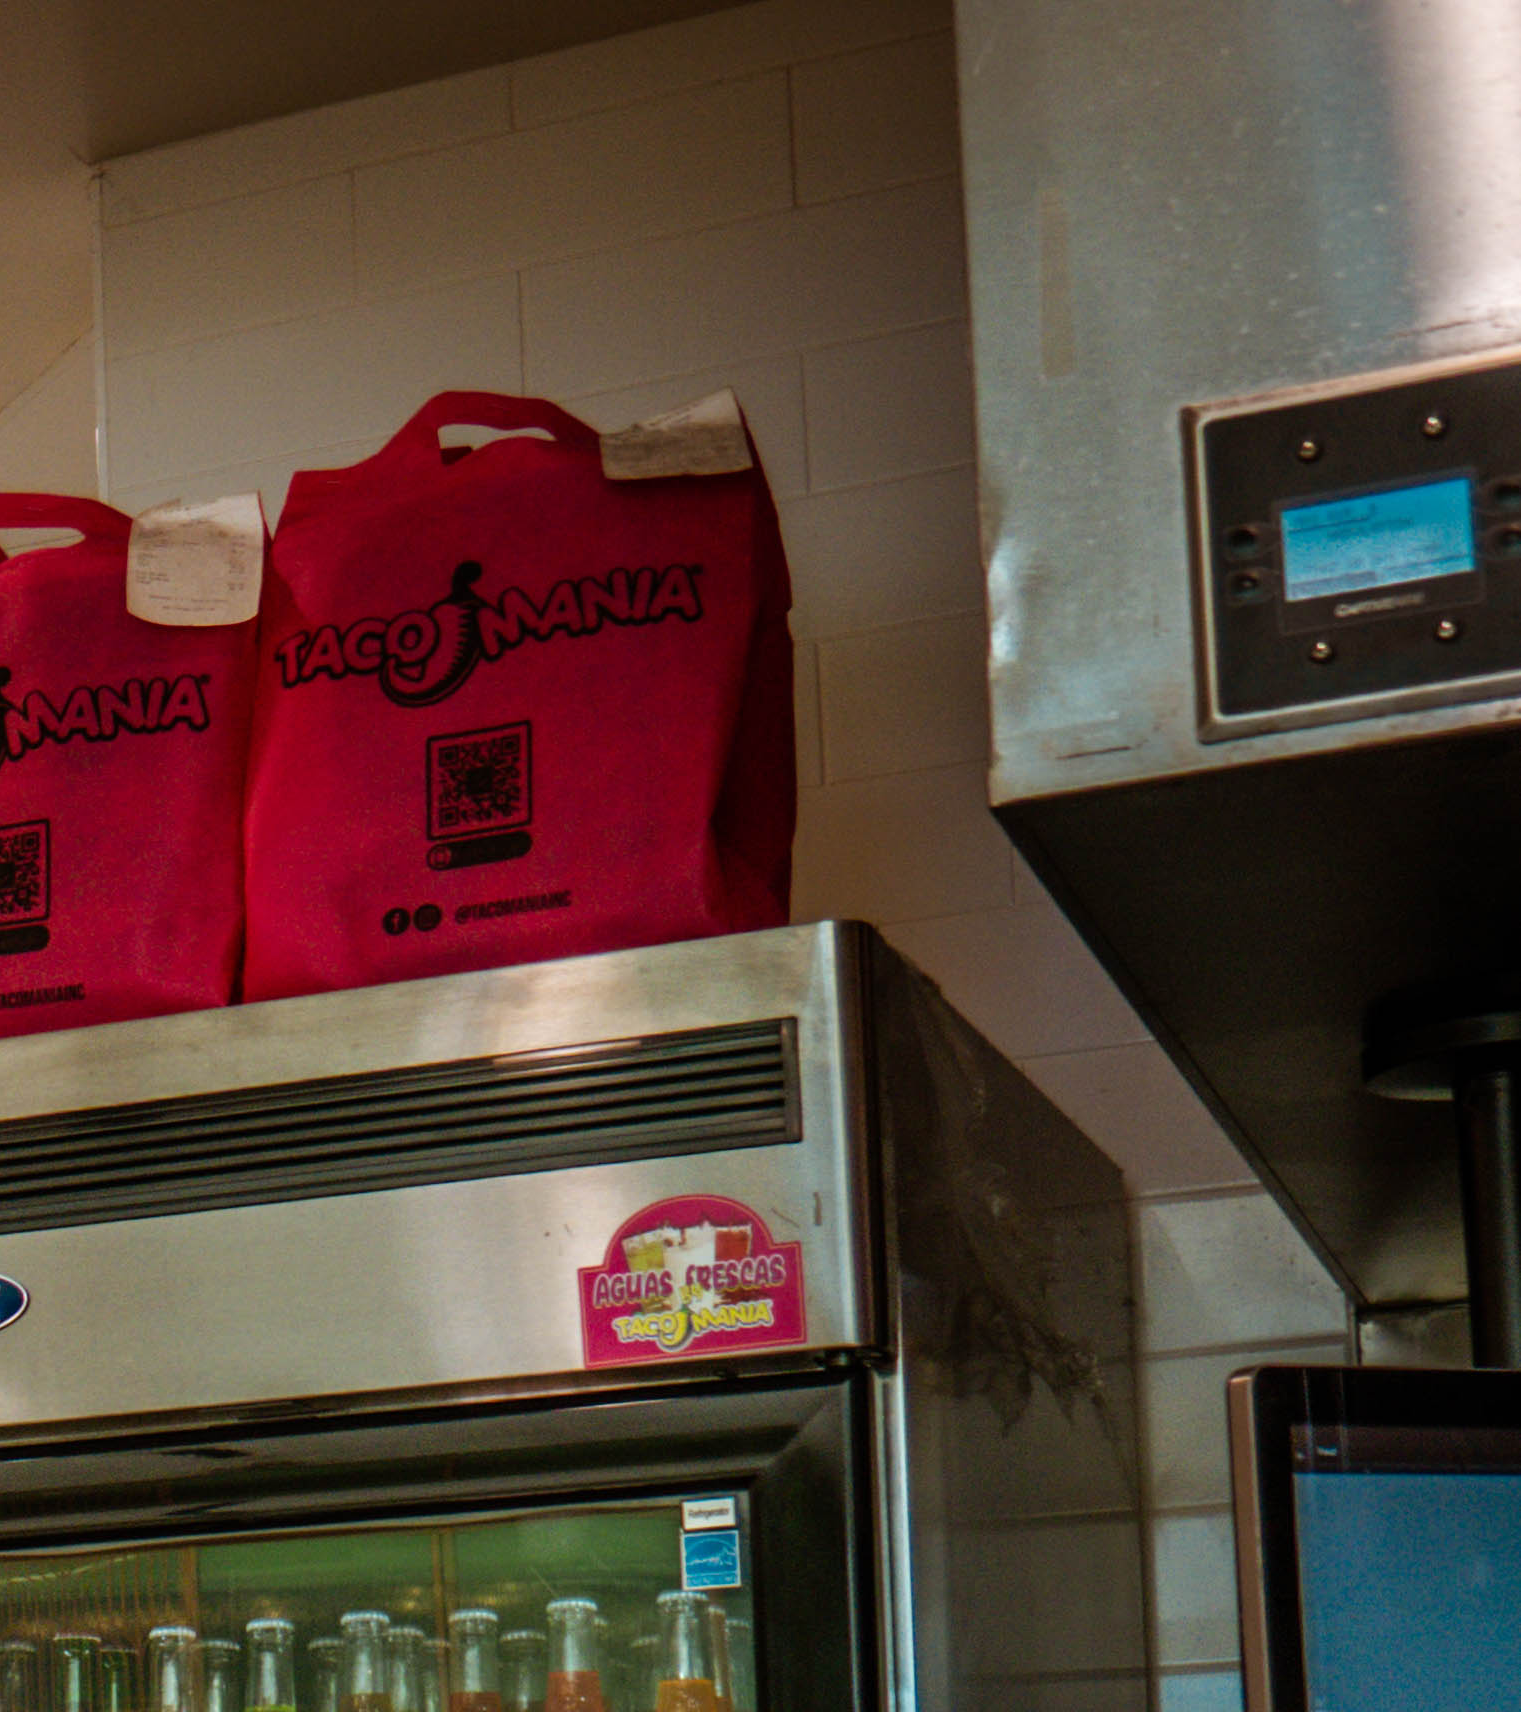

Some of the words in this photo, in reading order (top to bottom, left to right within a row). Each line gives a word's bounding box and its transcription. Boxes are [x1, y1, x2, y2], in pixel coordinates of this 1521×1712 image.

[275, 610, 441, 690] TACO
[477, 564, 697, 662] MANIA
[1, 674, 210, 762] MANIA
[594, 1270, 673, 1308] AGUAS
[685, 1254, 786, 1293] FRESCAS
[690, 1301, 773, 1334] MANIA
